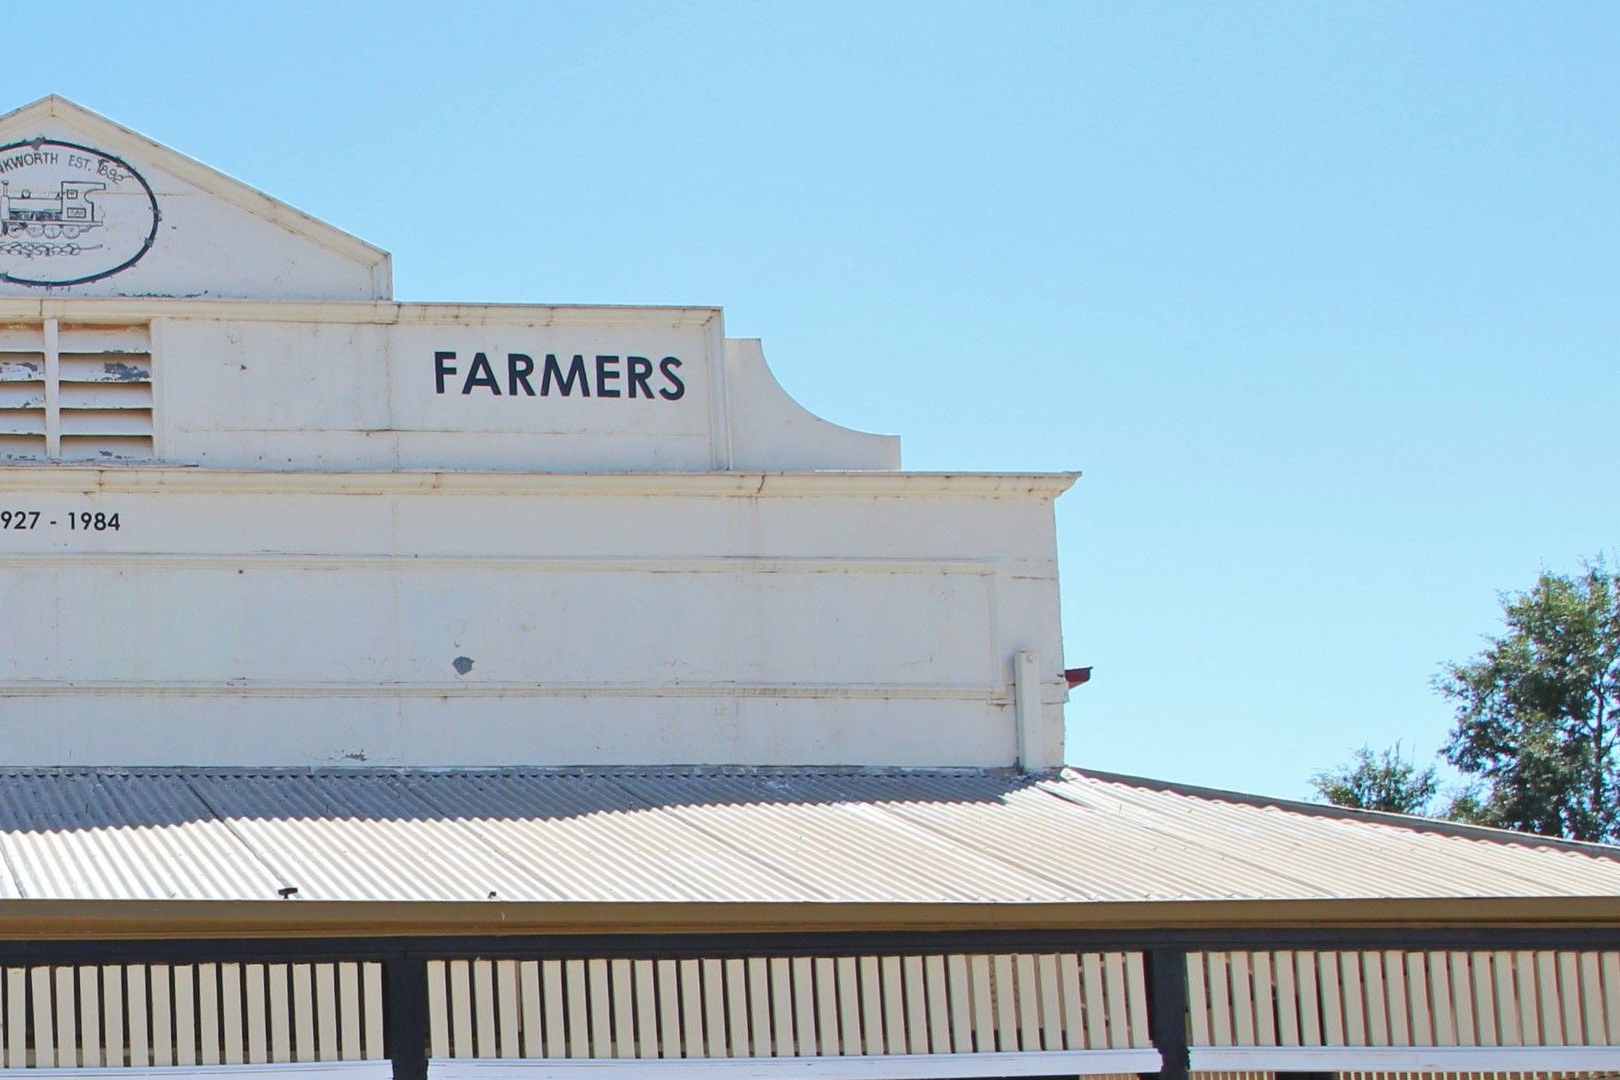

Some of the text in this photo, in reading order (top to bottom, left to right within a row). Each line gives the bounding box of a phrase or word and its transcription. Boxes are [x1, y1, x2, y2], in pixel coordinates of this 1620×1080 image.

[68, 155, 91, 172] EST.
[96, 160, 124, 185] 1892
[434, 351, 686, 401] FARMERS
[68, 512, 121, 531] 1984
